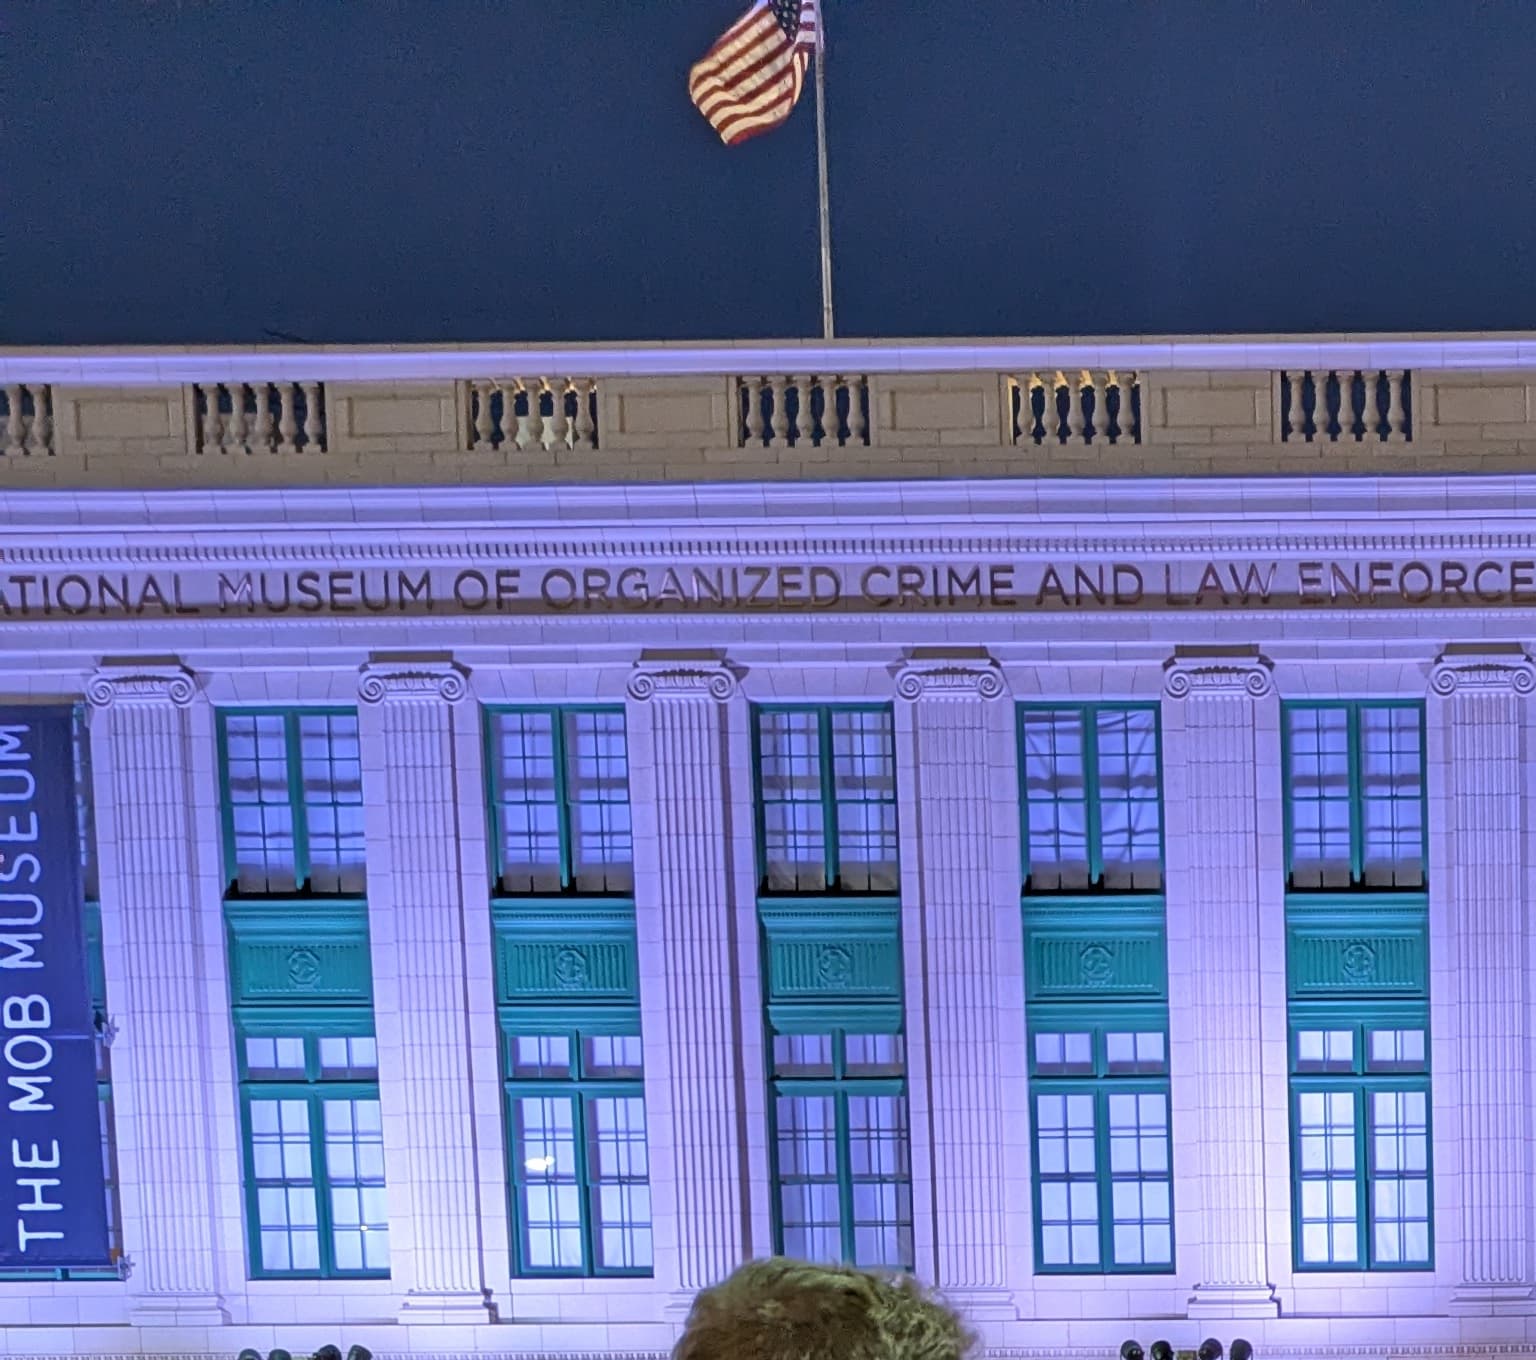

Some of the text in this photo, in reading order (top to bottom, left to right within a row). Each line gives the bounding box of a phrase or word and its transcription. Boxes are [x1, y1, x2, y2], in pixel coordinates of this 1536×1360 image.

[217, 570, 432, 615] MUSEUM
[453, 568, 520, 612] OF
[540, 566, 842, 612] ORGANIZED
[860, 564, 1016, 608] CRIME
[1036, 563, 1143, 607] AND
[1165, 562, 1277, 606] LAW
[0, 724, 64, 1253] THE MOB MUSEUM
